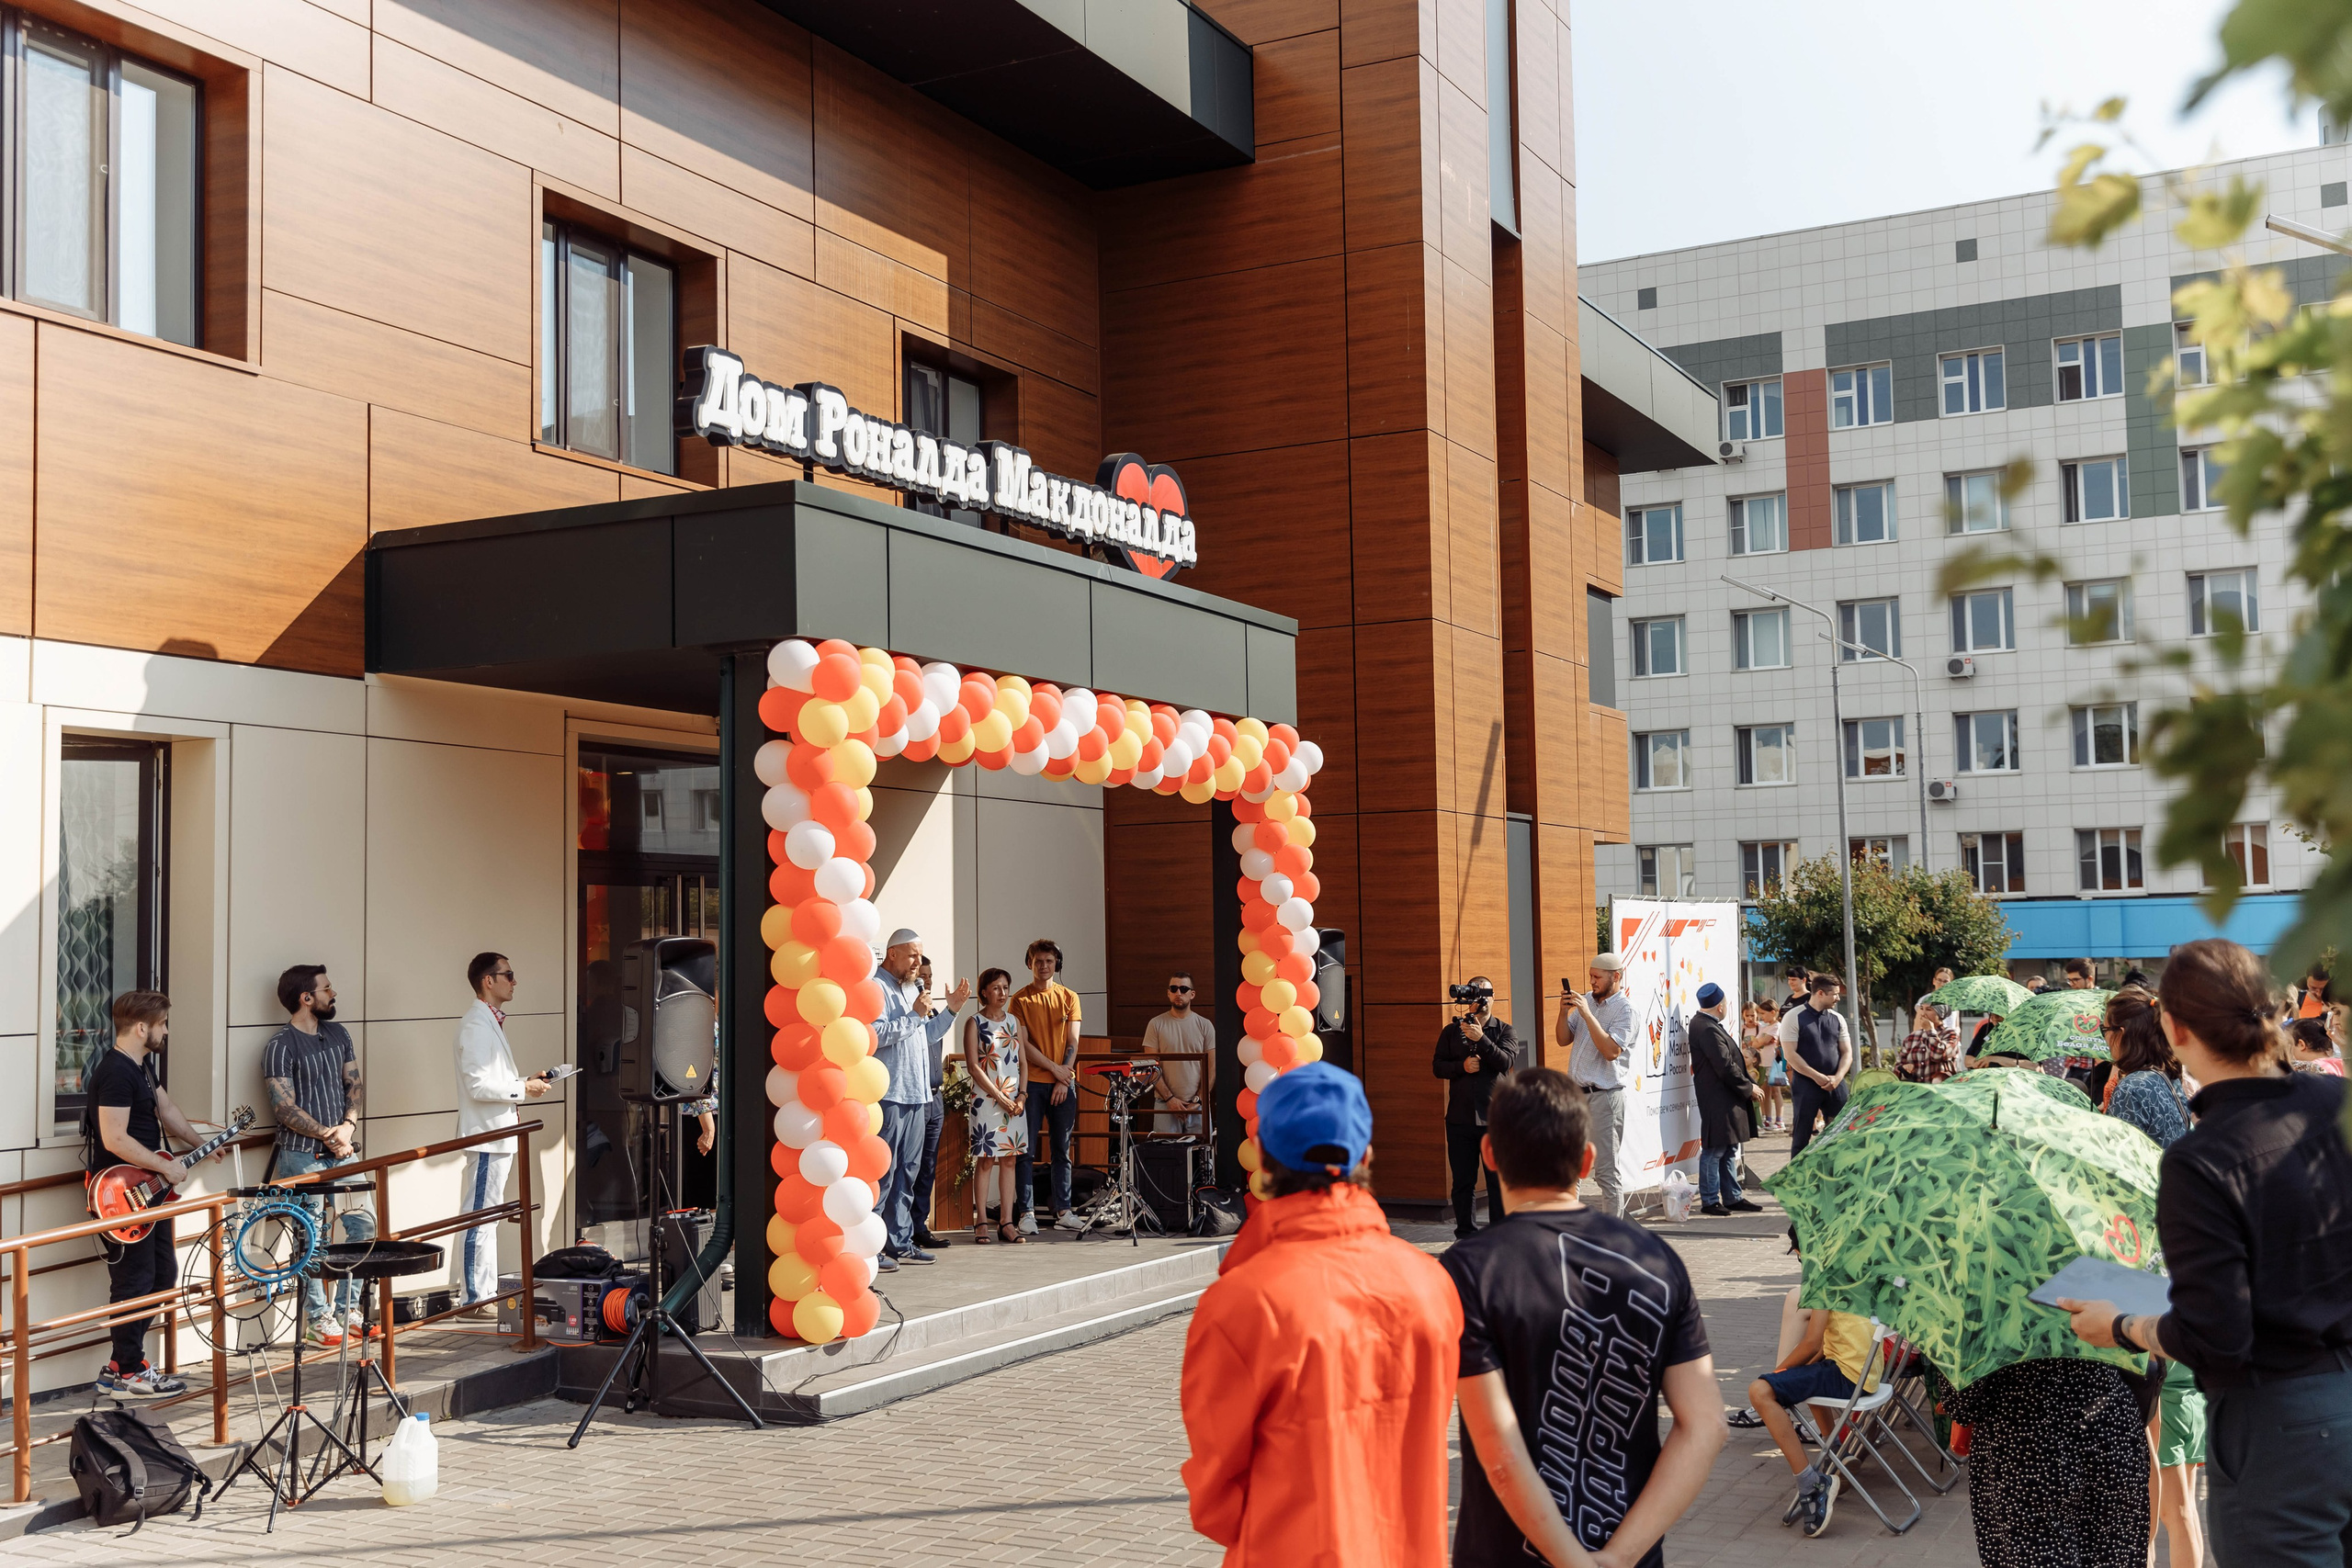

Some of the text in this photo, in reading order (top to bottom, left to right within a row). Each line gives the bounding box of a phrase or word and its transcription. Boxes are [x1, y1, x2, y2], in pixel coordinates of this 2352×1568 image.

[699, 353, 1197, 562] Дом Роналда Макдоналда
[1668, 1016, 1683, 1037] Дом
[2057, 1040, 2089, 1049] Белая
[1668, 1064, 1687, 1077] Россия
